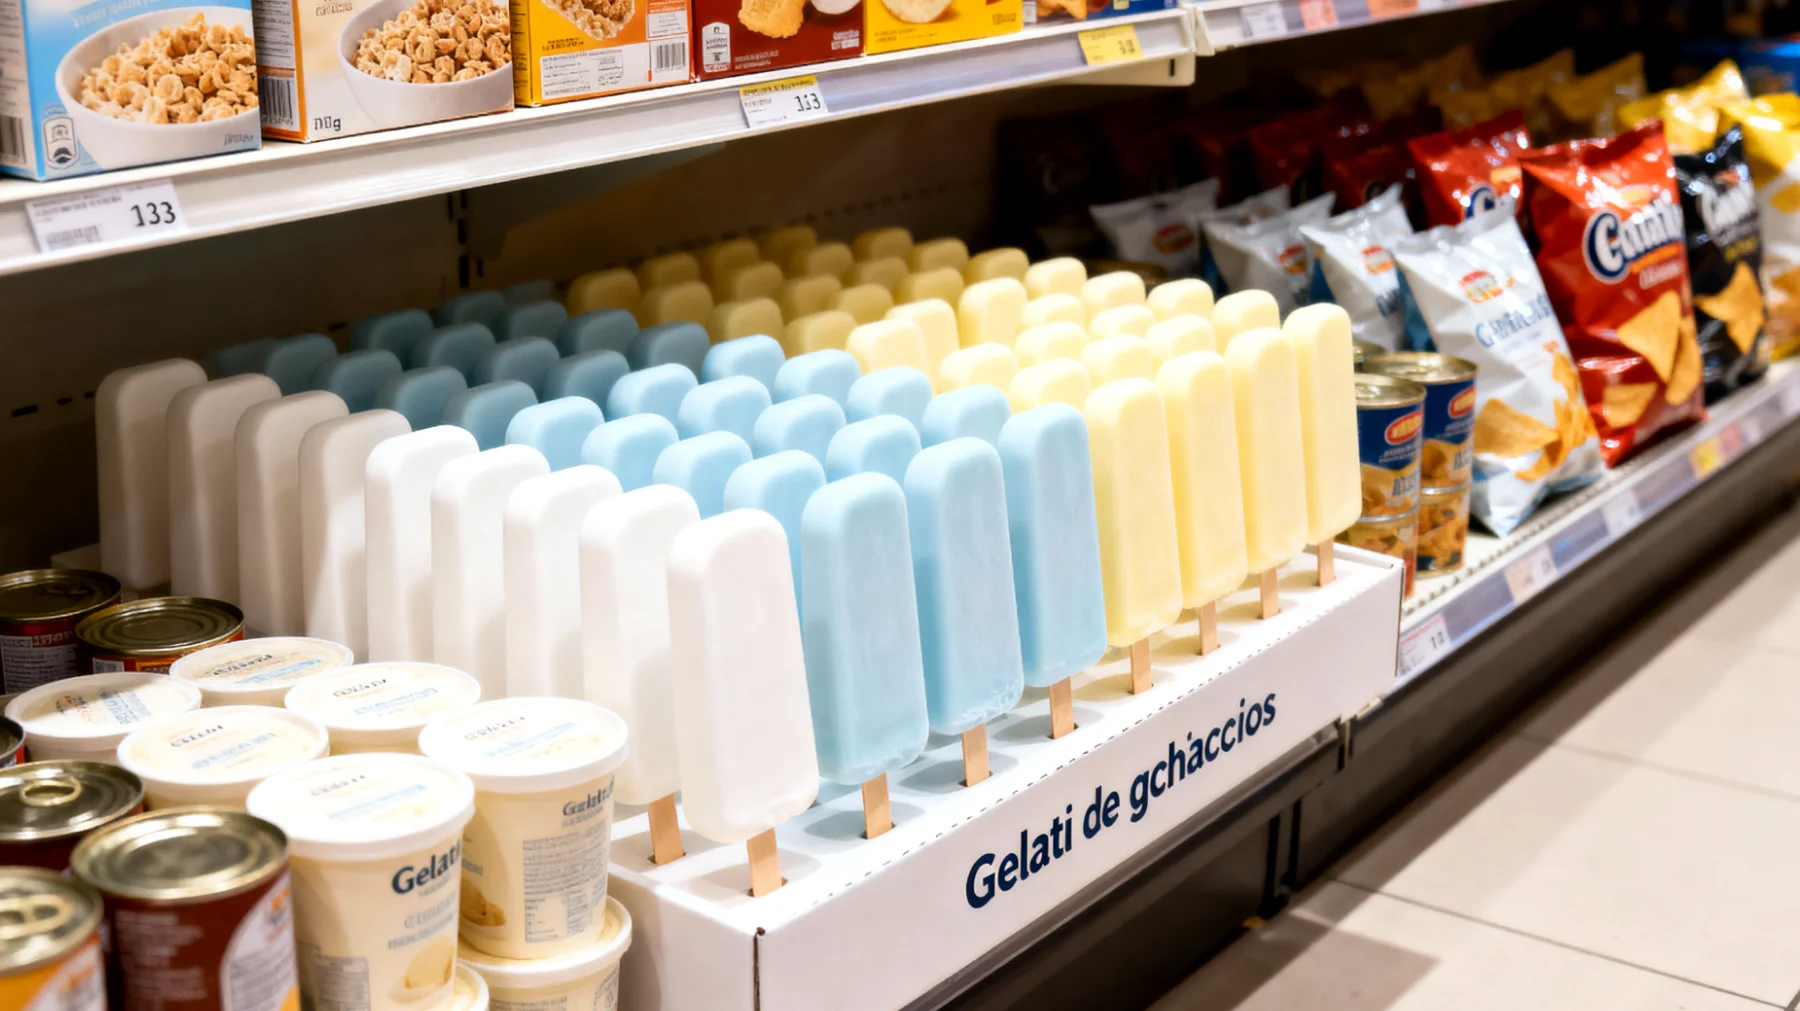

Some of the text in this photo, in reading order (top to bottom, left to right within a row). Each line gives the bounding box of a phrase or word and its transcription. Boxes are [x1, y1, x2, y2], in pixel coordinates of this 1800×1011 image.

[130, 201, 176, 228] 133
[965, 804, 1074, 909] Gelati
[1082, 785, 1120, 840] de
